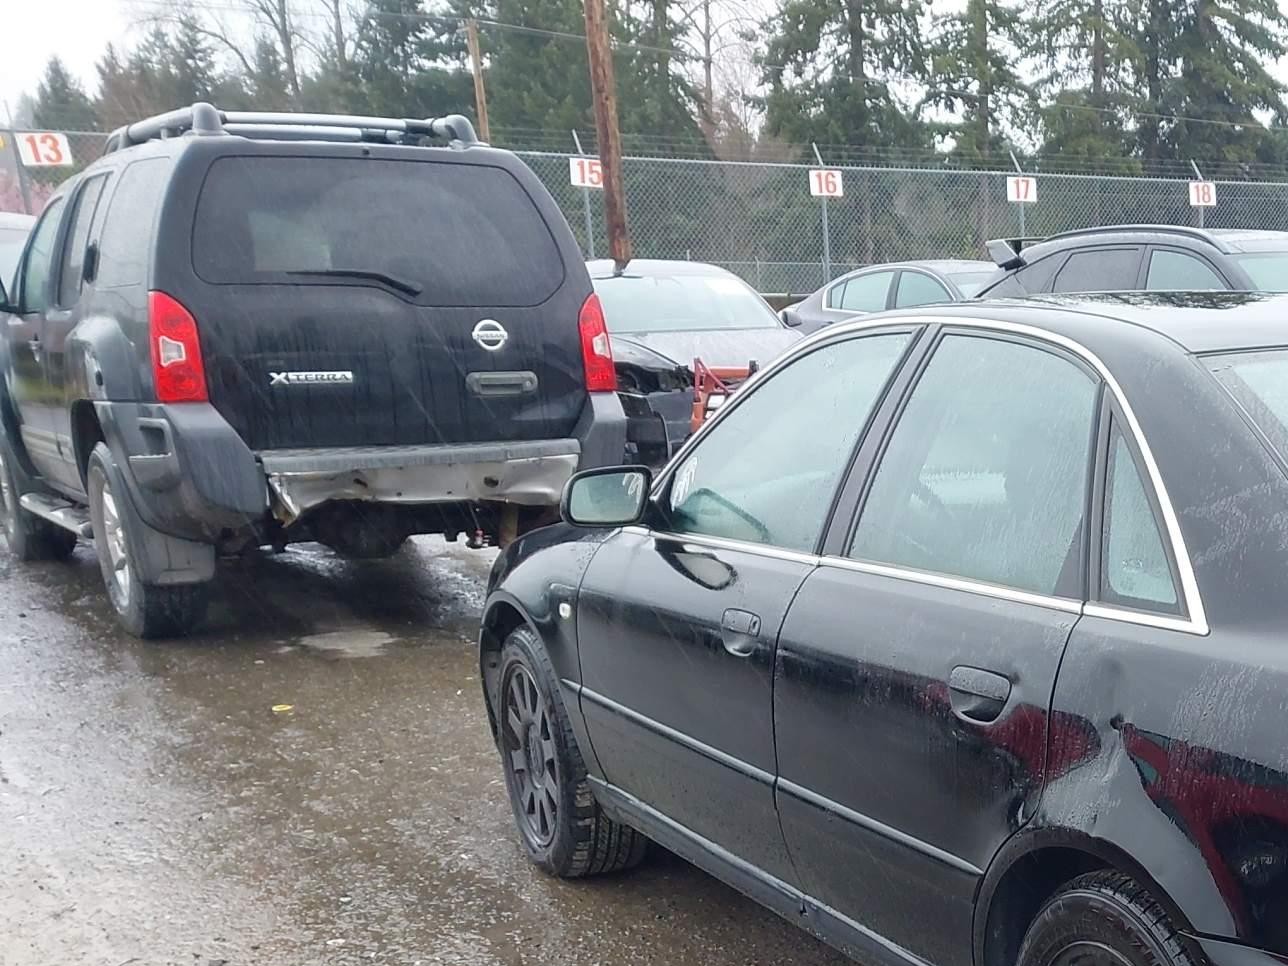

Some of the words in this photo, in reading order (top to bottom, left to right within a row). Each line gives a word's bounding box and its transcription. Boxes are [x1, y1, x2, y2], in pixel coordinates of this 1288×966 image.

[25, 133, 63, 164] 13
[577, 160, 603, 186] 15
[815, 172, 837, 194] 16
[1013, 179, 1030, 199] 17
[1194, 184, 1212, 204] 18
[269, 371, 352, 385] XTERRA
